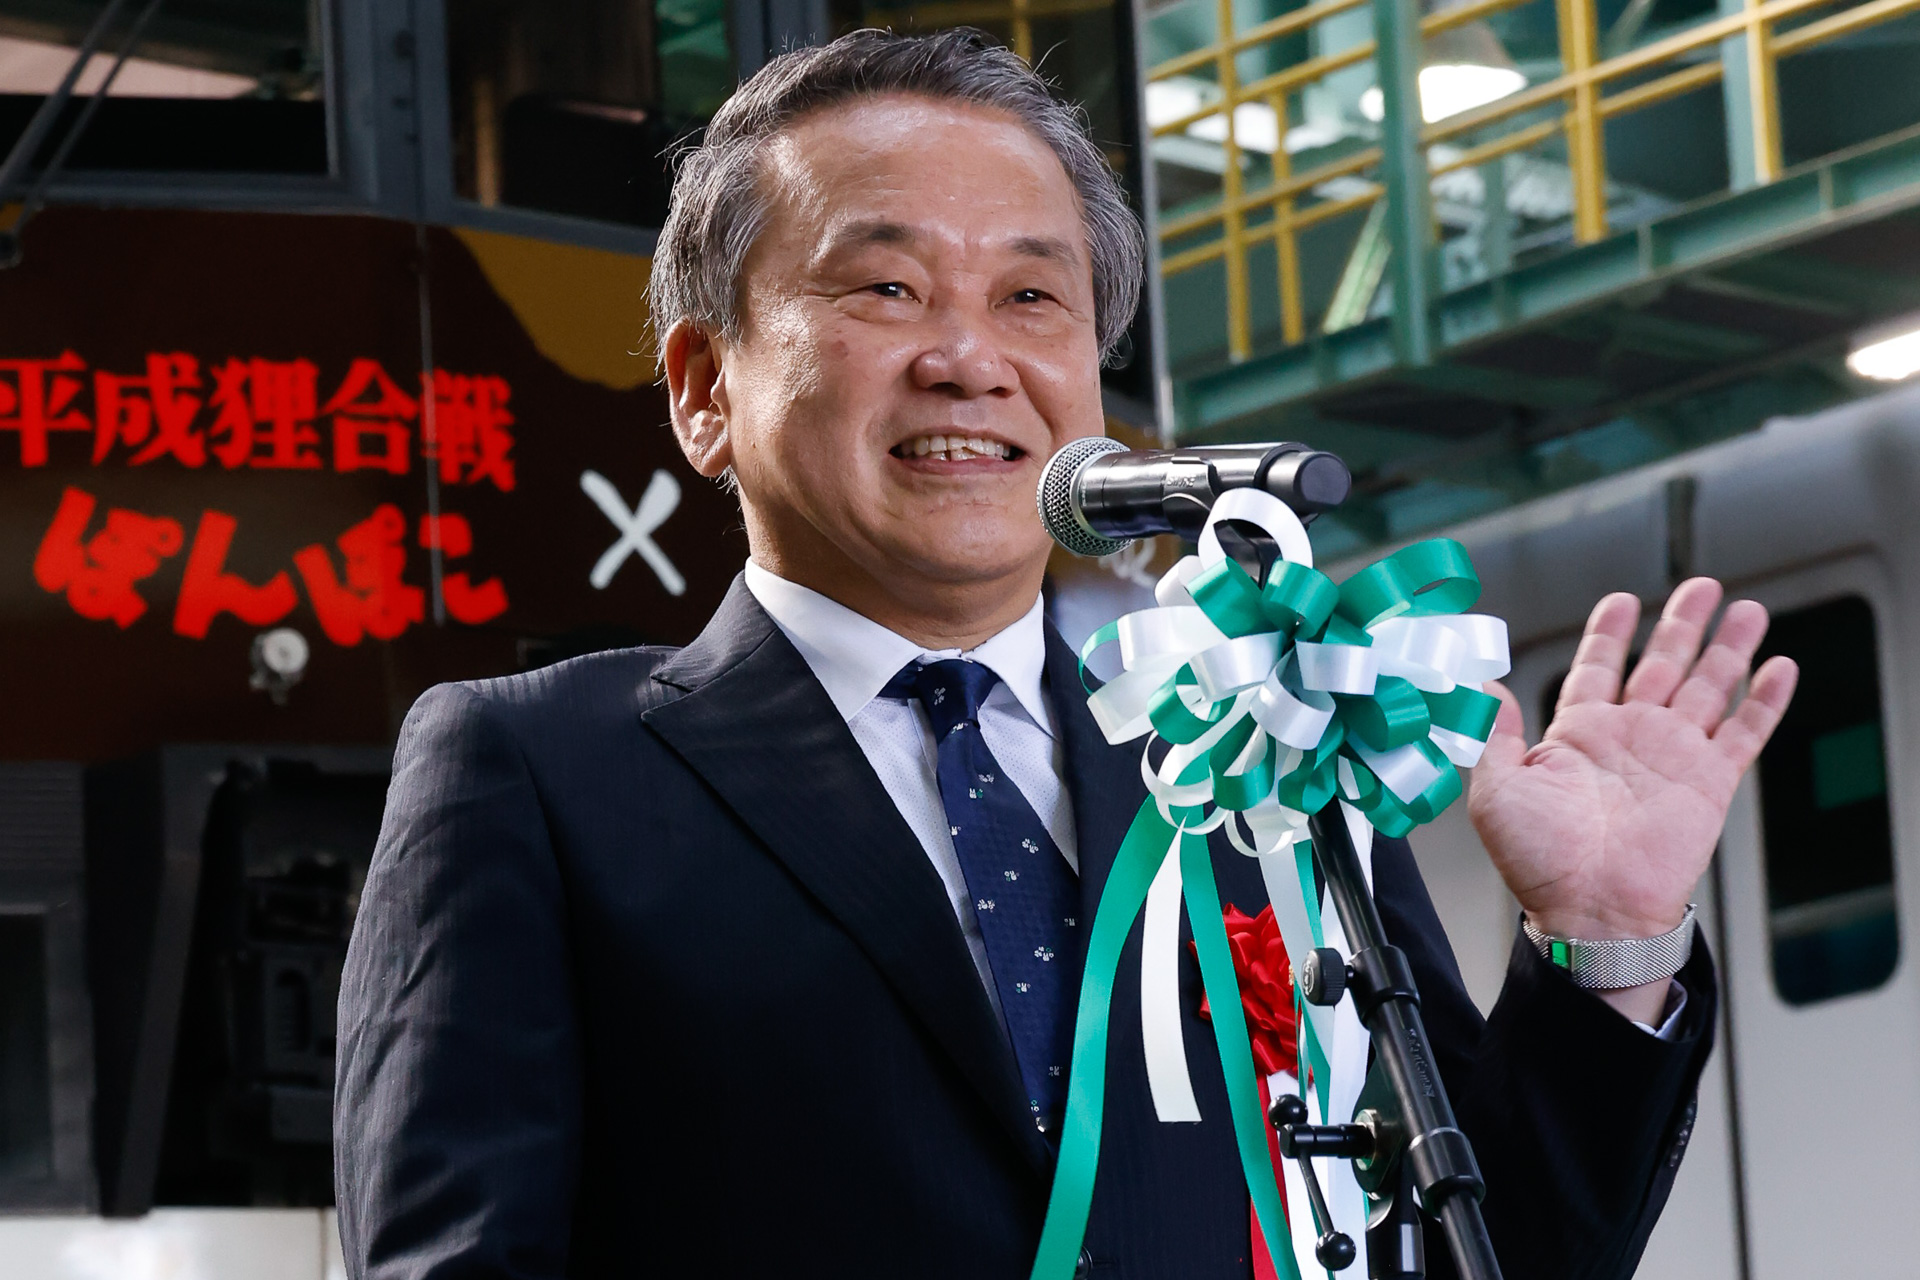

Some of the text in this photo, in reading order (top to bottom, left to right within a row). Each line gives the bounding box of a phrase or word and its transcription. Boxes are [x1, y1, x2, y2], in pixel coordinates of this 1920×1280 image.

[0, 350, 516, 492] 平成狸合戦
[33, 485, 509, 647] ぽんぽこ
